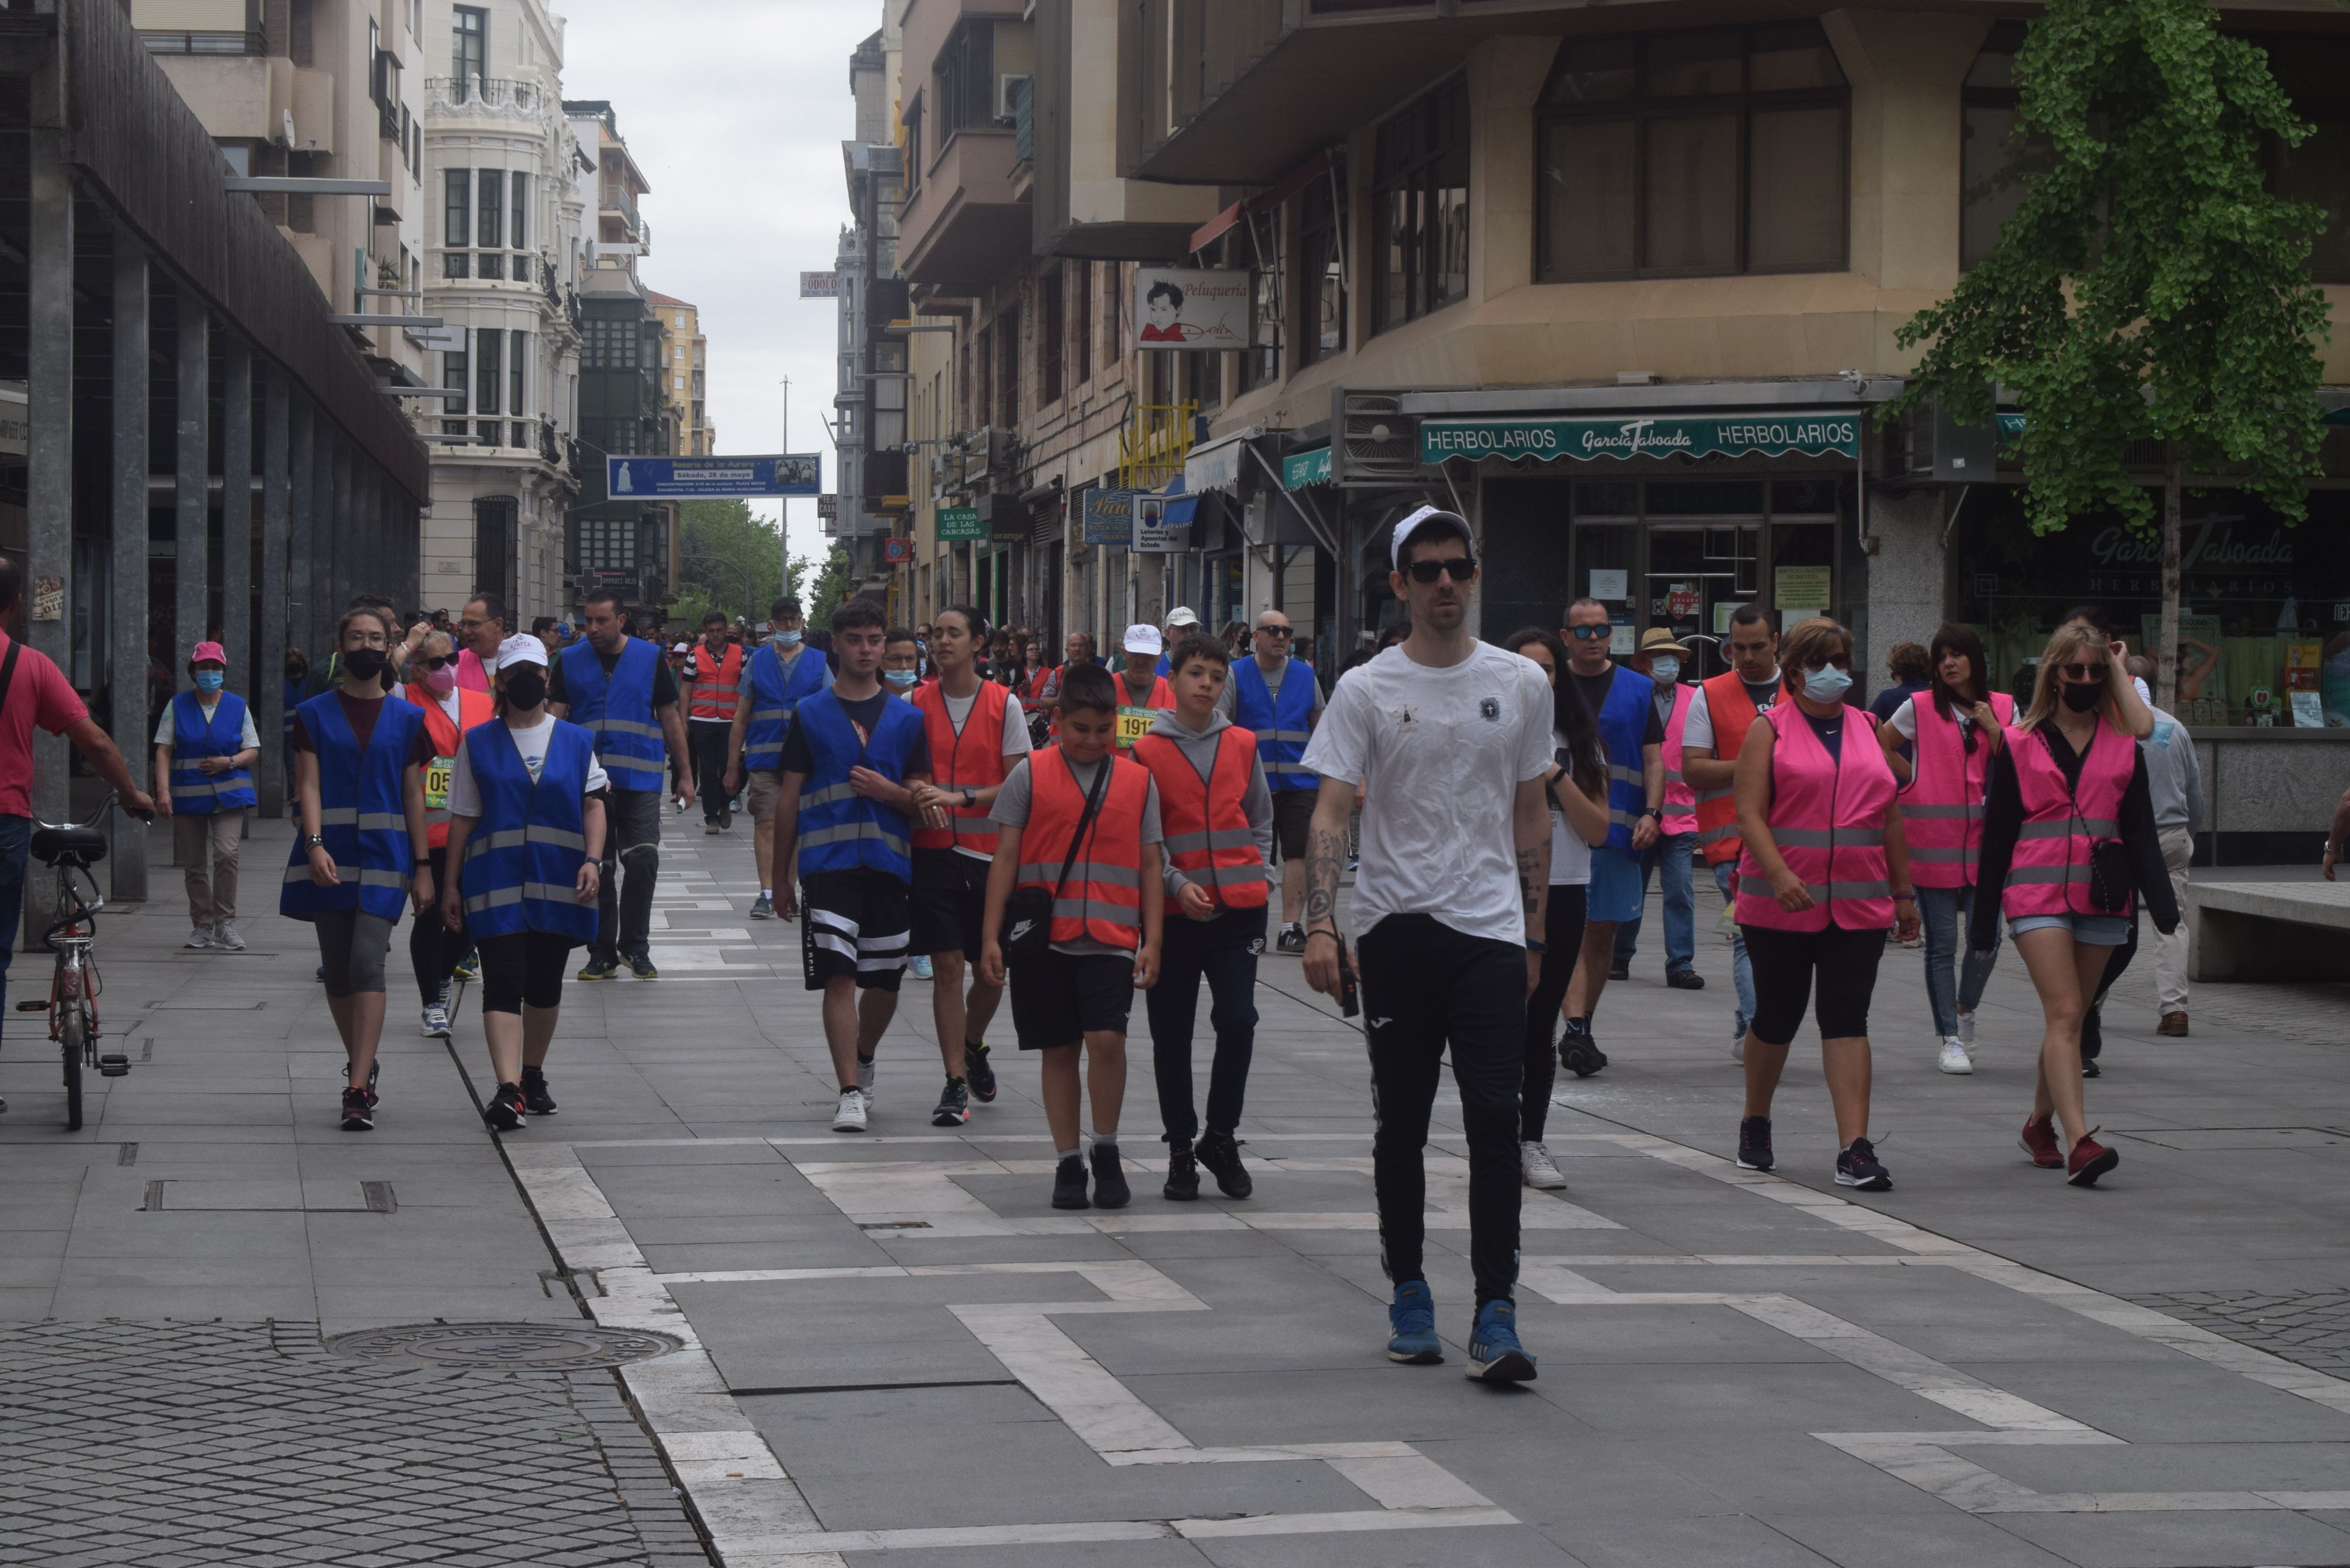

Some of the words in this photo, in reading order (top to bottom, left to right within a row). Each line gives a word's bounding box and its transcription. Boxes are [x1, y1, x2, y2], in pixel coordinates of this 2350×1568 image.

[803, 279, 837, 290] ODOLO
[1182, 282, 1247, 301] Peluquería
[1427, 429, 1556, 449] HERBOLARIOS
[1717, 423, 1854, 444] HERBOLARIOS
[819, 504, 836, 513] CAXA
[993, 533, 1024, 541] orange
[2091, 527, 2164, 565] Garc
[2091, 579, 2293, 594] HERBLARIOS
[510, 640, 531, 651] AZAYCA
[430, 771, 451, 792] 05
[1013, 919, 1032, 933] NIKE
